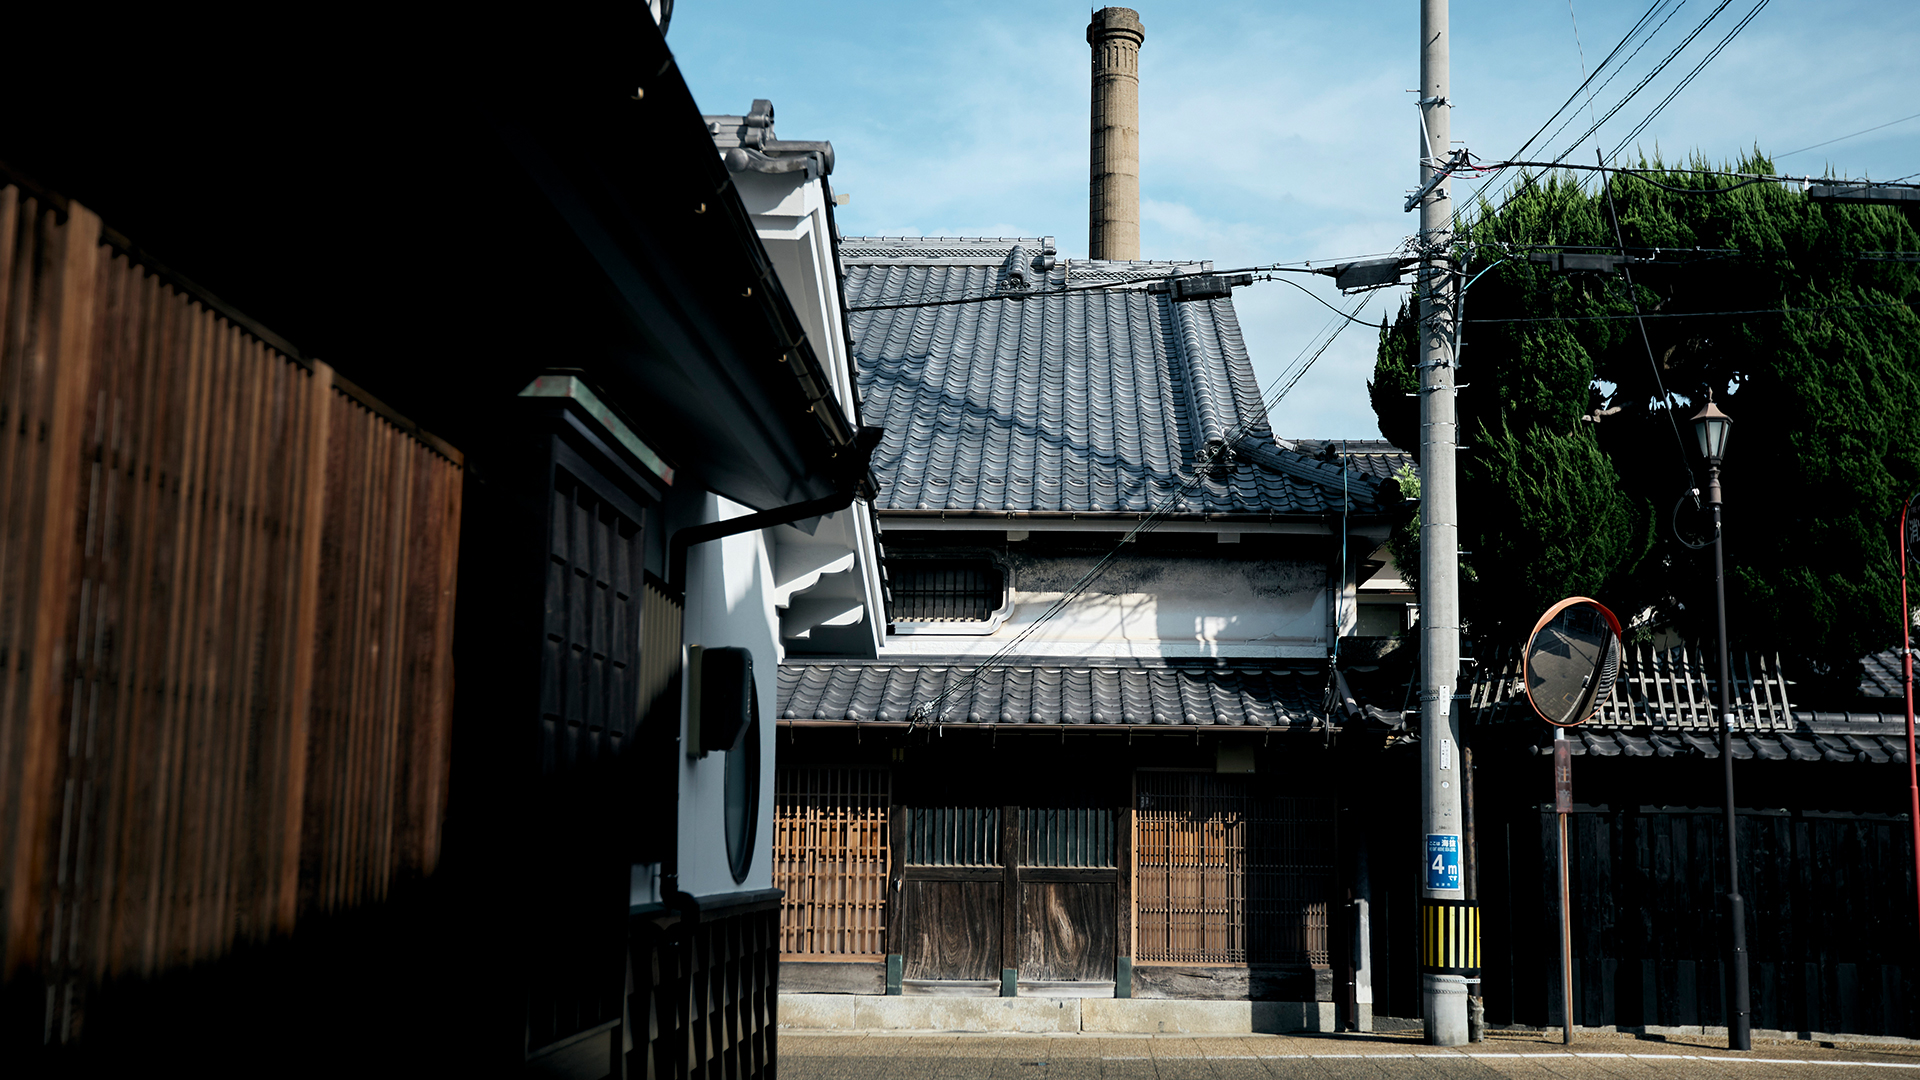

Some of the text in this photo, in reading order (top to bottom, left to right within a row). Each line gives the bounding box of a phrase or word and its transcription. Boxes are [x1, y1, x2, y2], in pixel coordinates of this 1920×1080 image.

[1909, 518, 1920, 544] 消
[1432, 854, 1457, 874] 4 m
